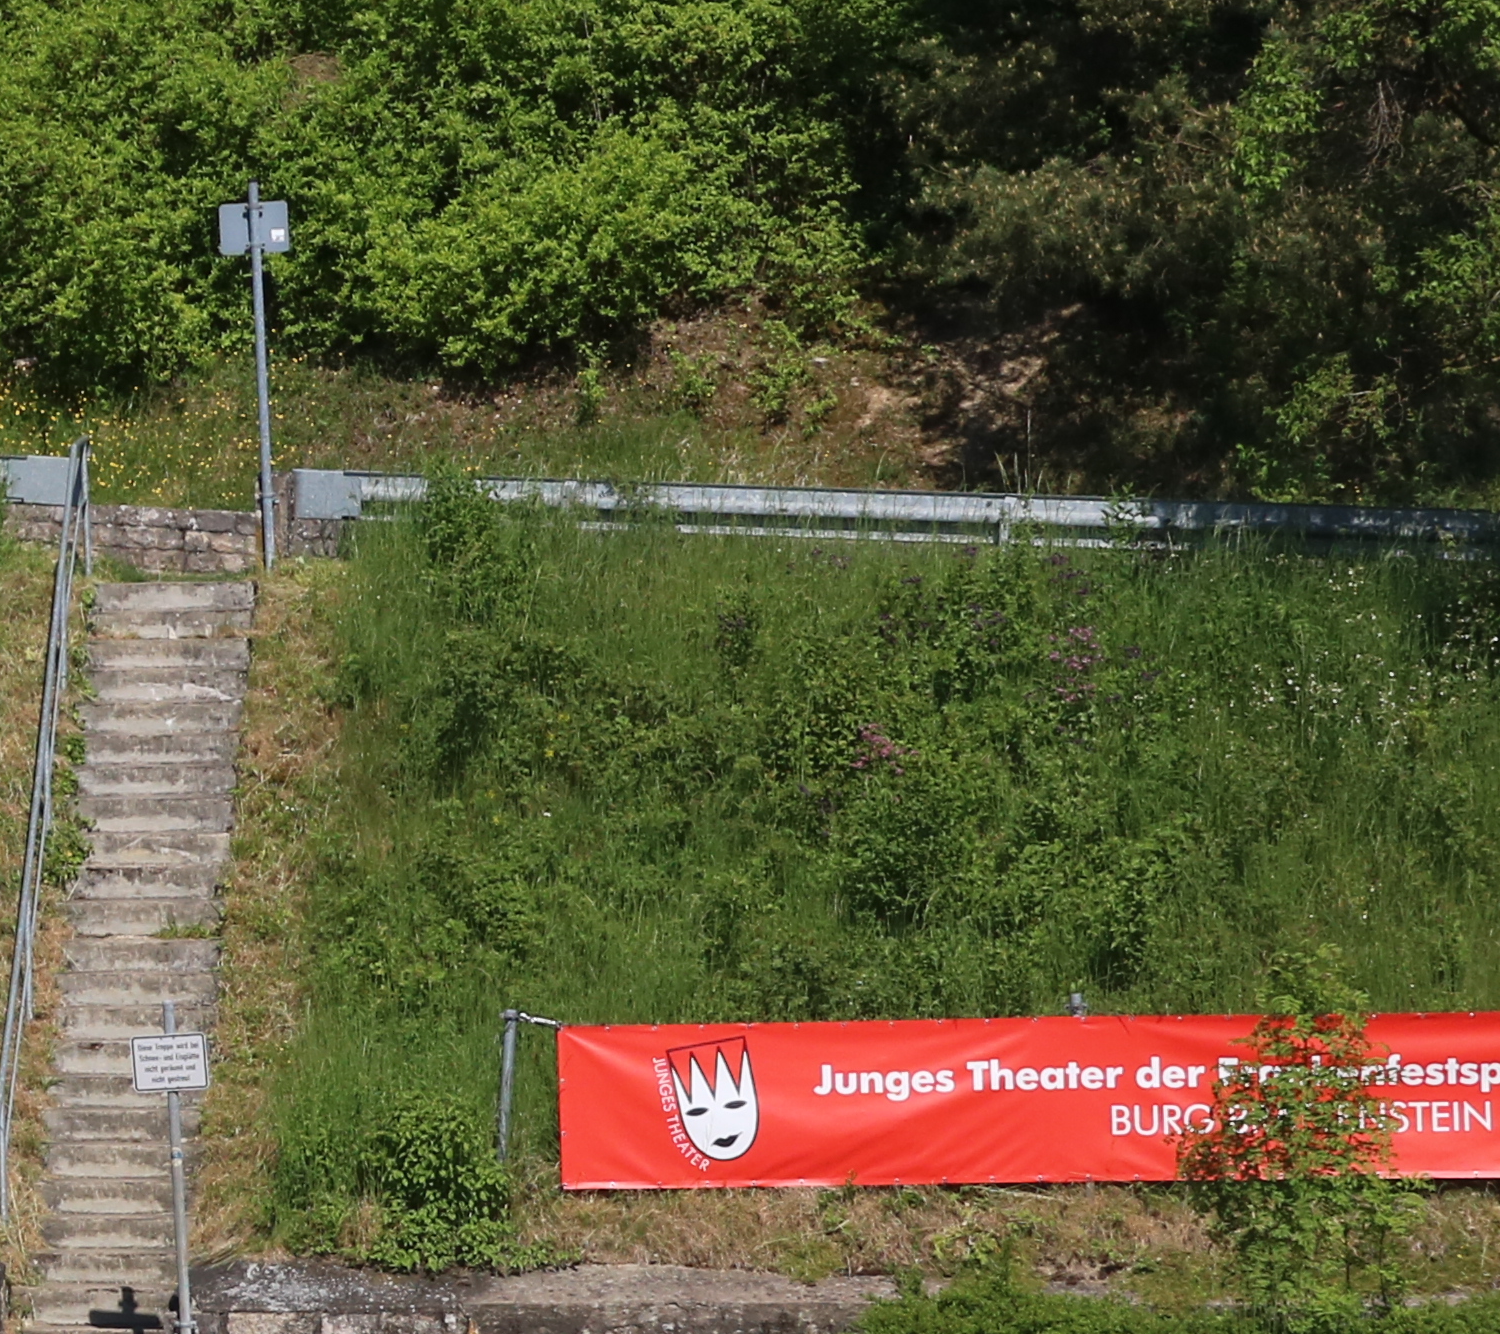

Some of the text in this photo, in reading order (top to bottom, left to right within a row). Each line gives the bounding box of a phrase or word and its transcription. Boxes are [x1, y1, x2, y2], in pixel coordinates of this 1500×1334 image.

[813, 1064, 955, 1101] Junges
[966, 1059, 1124, 1091] Theater
[1135, 1056, 1205, 1089] der
[652, 1057, 711, 1172] JUNGES THEATER
[1111, 1103, 1214, 1136] BURG
